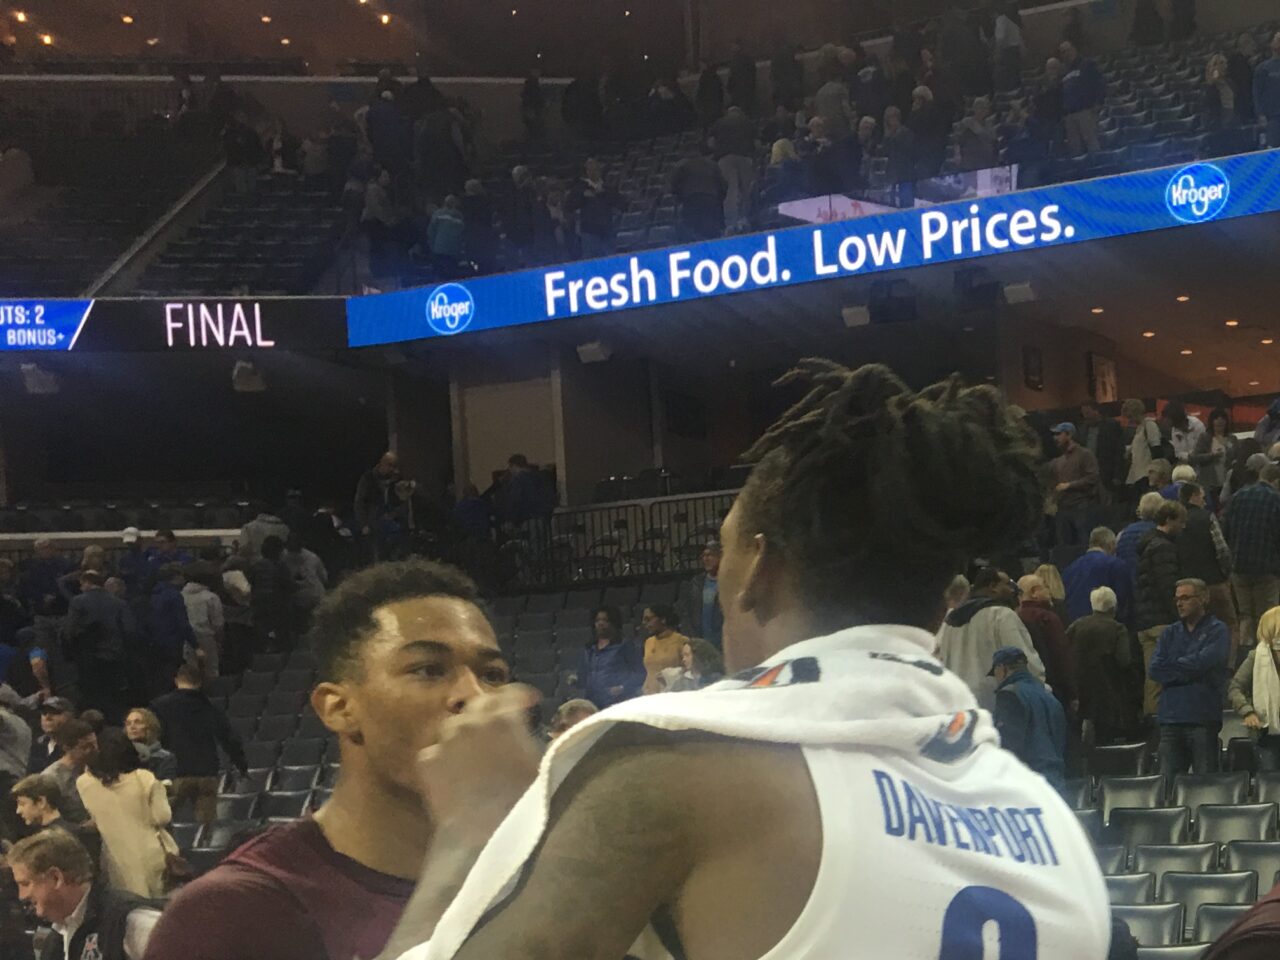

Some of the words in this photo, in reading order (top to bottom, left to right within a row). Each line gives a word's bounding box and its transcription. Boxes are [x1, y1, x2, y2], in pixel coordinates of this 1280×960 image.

[1172, 175, 1224, 216] Kroger
[544, 257, 657, 316] Fresh
[668, 235, 791, 297] Food.
[812, 228, 907, 275] Low
[921, 203, 1075, 259] Prices.
[34, 305, 45, 324] 2
[165, 302, 275, 347] FINAL
[431, 293, 471, 328] Kroger
[873, 769, 1060, 867] DAVENPORT
